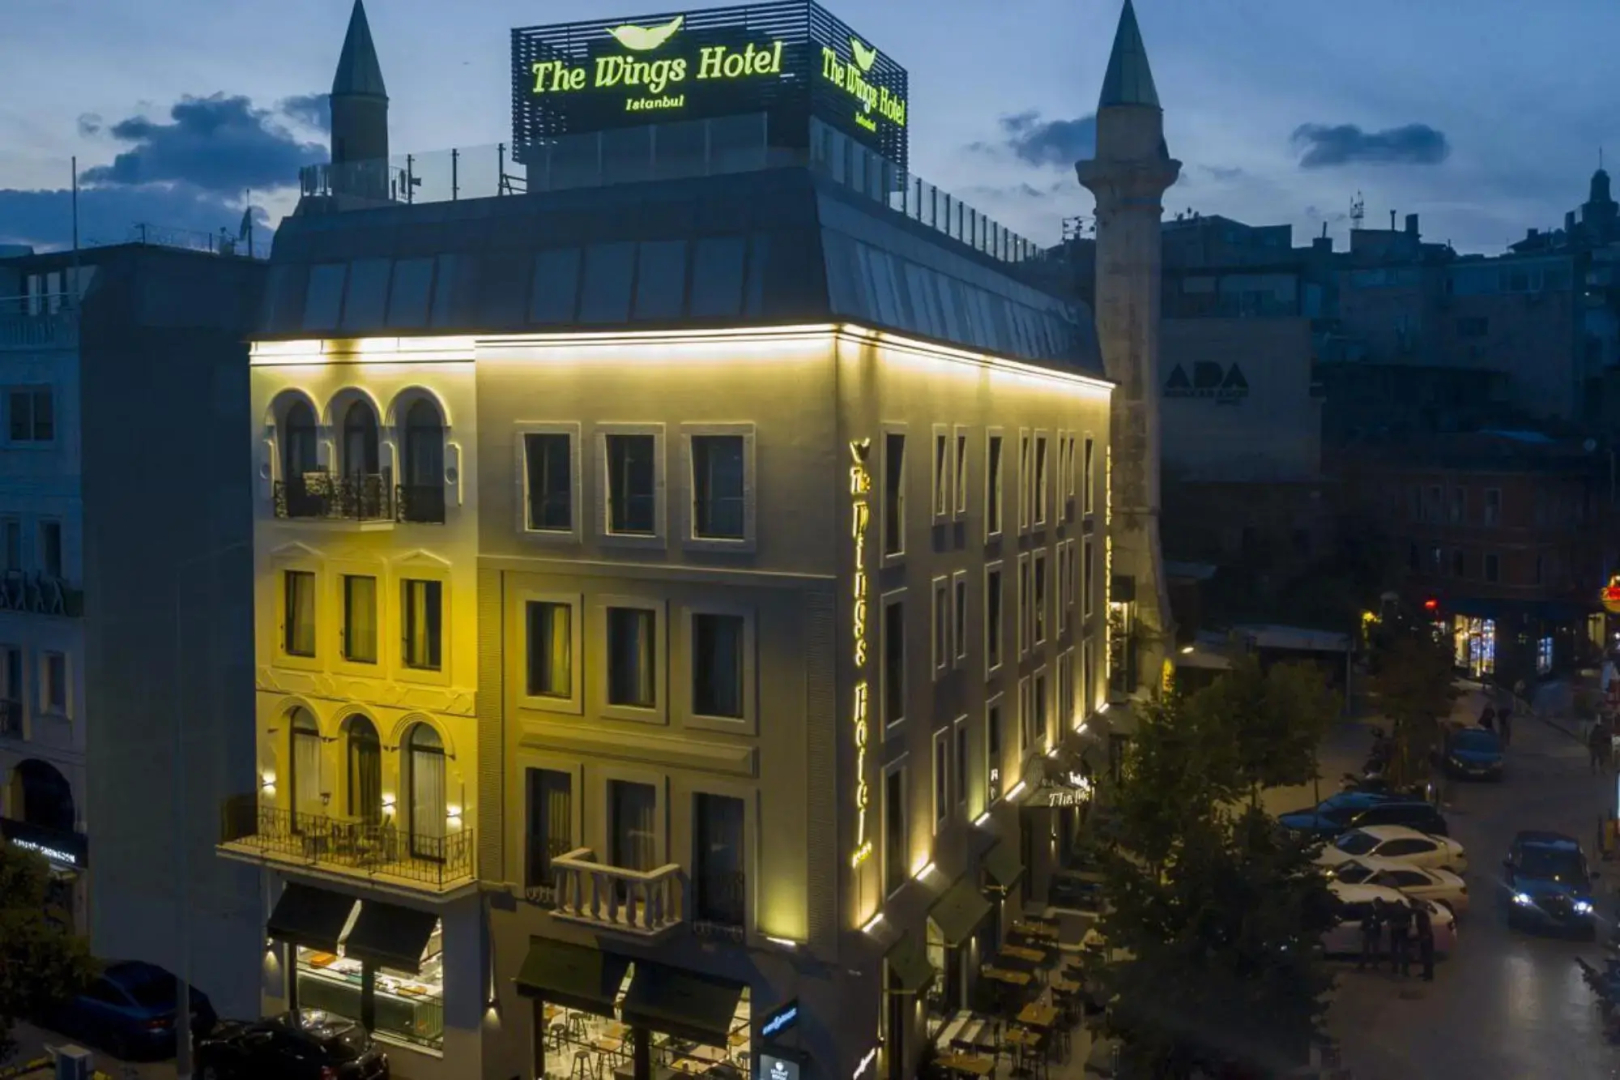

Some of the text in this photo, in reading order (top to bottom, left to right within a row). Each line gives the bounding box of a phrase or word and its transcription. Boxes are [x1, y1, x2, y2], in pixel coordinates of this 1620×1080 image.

[532, 41, 782, 93] The Wings Hotel
[822, 46, 905, 126] The Wings Hotel
[625, 94, 685, 111] Istanbul
[1164, 360, 1249, 388] ADA
